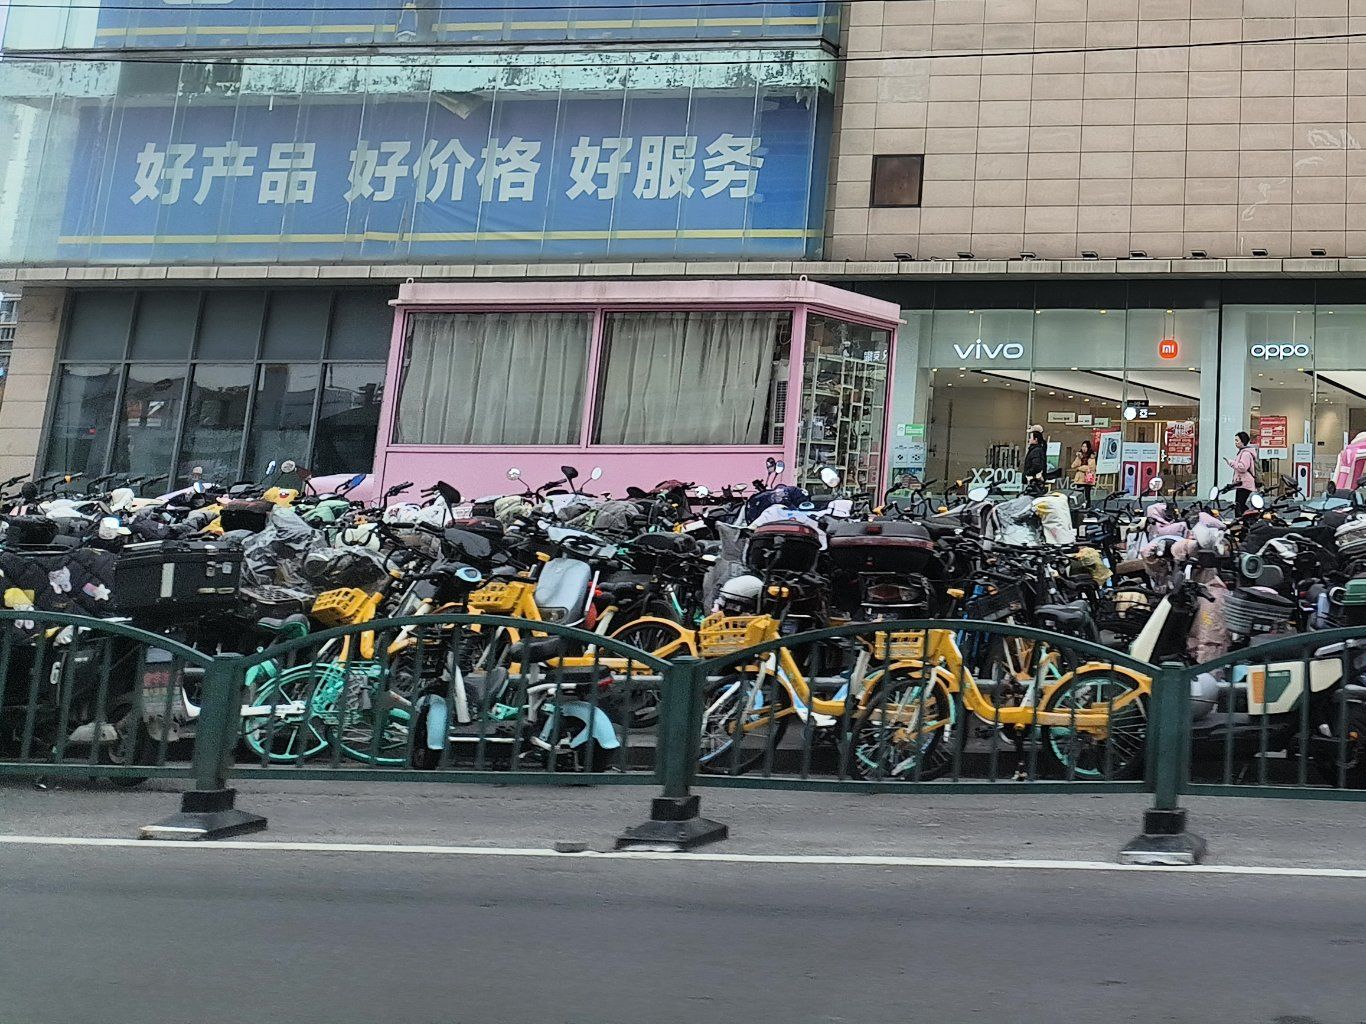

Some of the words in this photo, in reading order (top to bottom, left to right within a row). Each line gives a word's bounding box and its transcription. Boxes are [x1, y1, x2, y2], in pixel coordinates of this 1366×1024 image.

[129, 140, 318, 205] 好产品
[344, 137, 542, 204] 好价格
[564, 134, 765, 201] 好服务
[953, 339, 1024, 359] vivo
